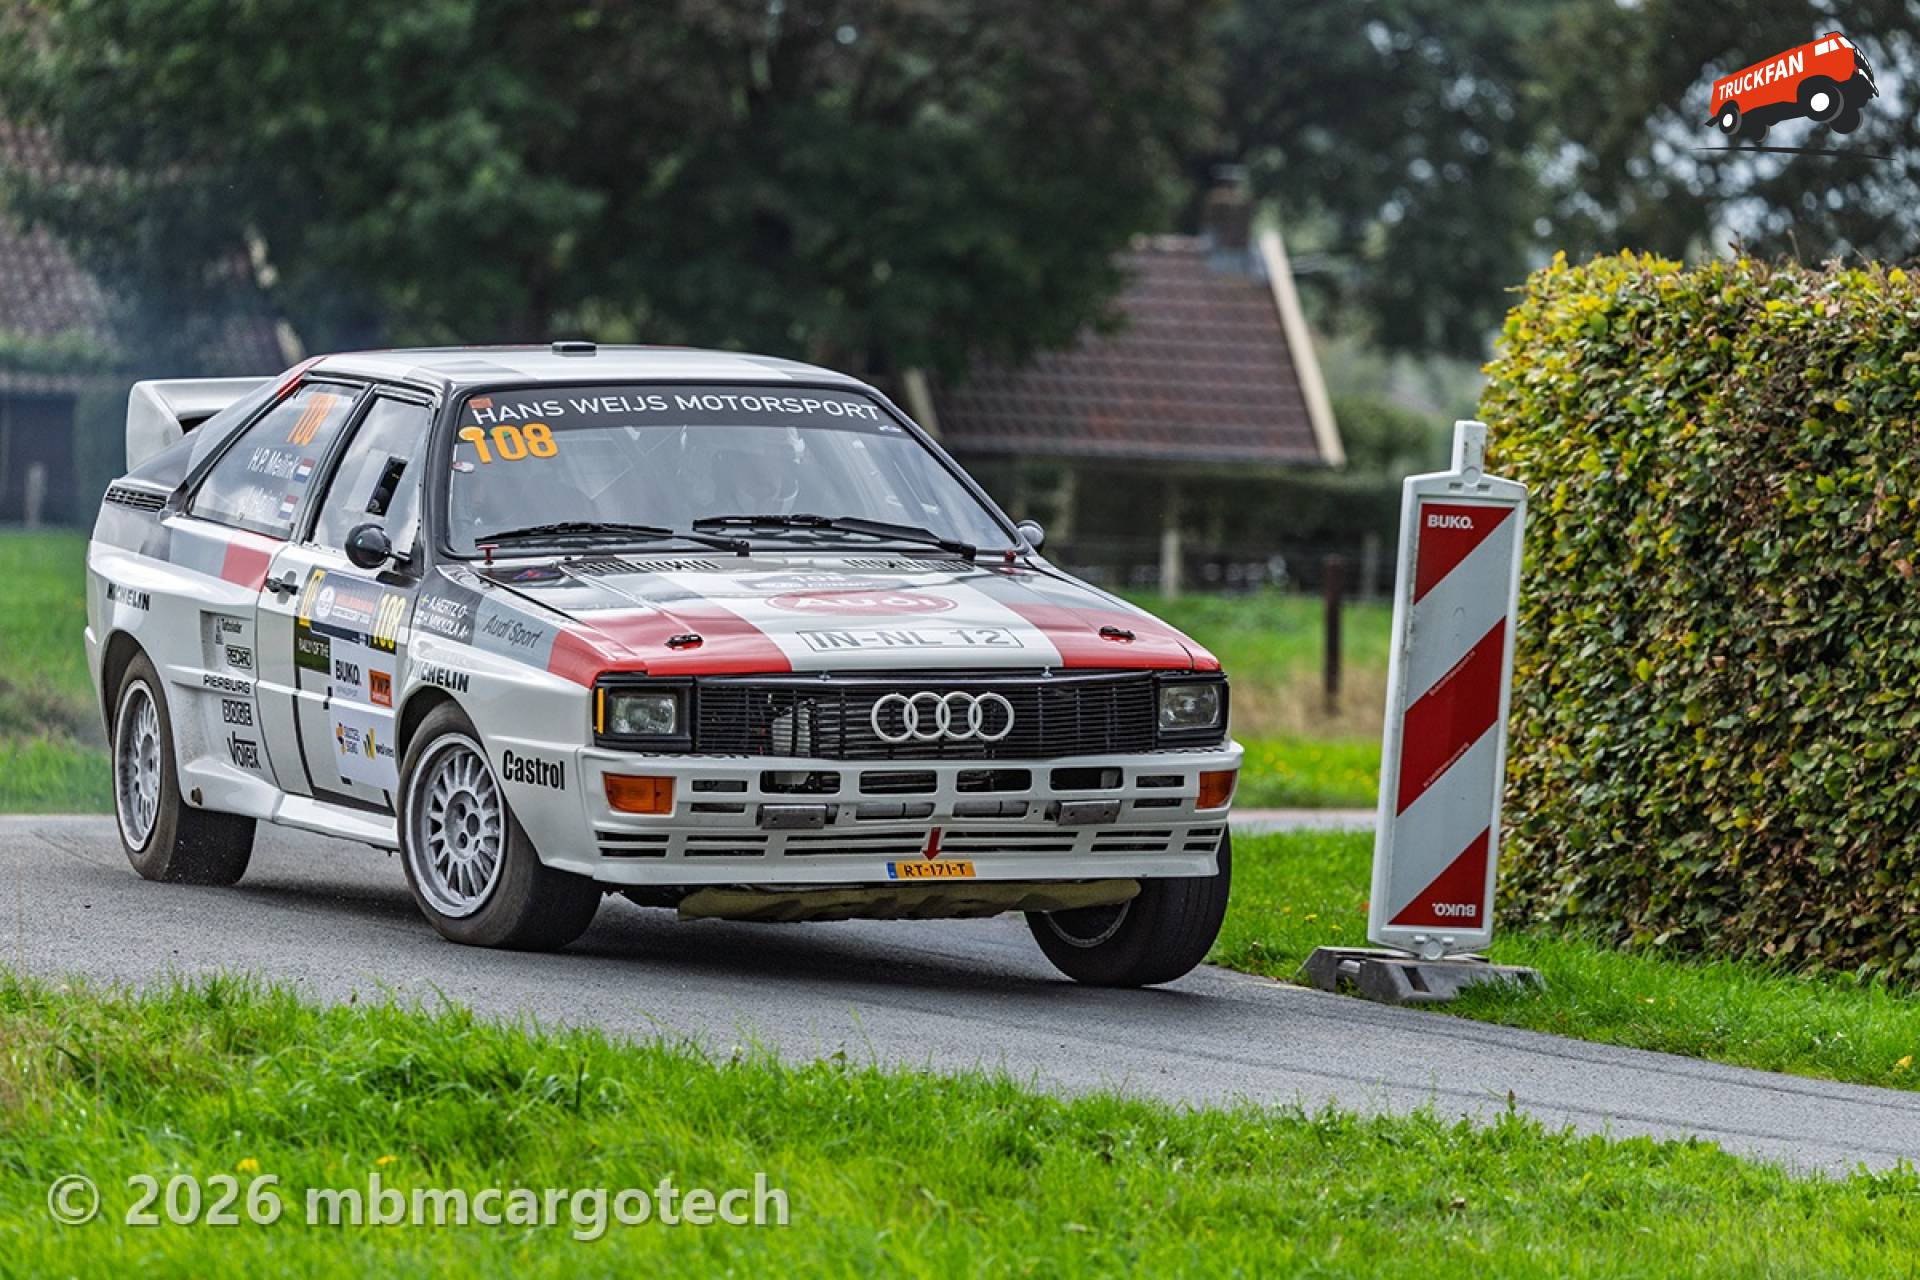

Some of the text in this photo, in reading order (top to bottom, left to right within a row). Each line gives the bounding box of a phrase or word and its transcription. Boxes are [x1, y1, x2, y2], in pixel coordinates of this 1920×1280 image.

[472, 394, 879, 425] HANS WEIJS MOTORSPORT
[459, 422, 559, 464] 108
[482, 613, 544, 649] Audi Sport
[804, 628, 1011, 649] IN-NL 12
[203, 674, 251, 695] PIERBURG
[222, 699, 253, 726] BOGE
[503, 749, 566, 790] Castrol
[903, 863, 966, 877] RT-171-T
